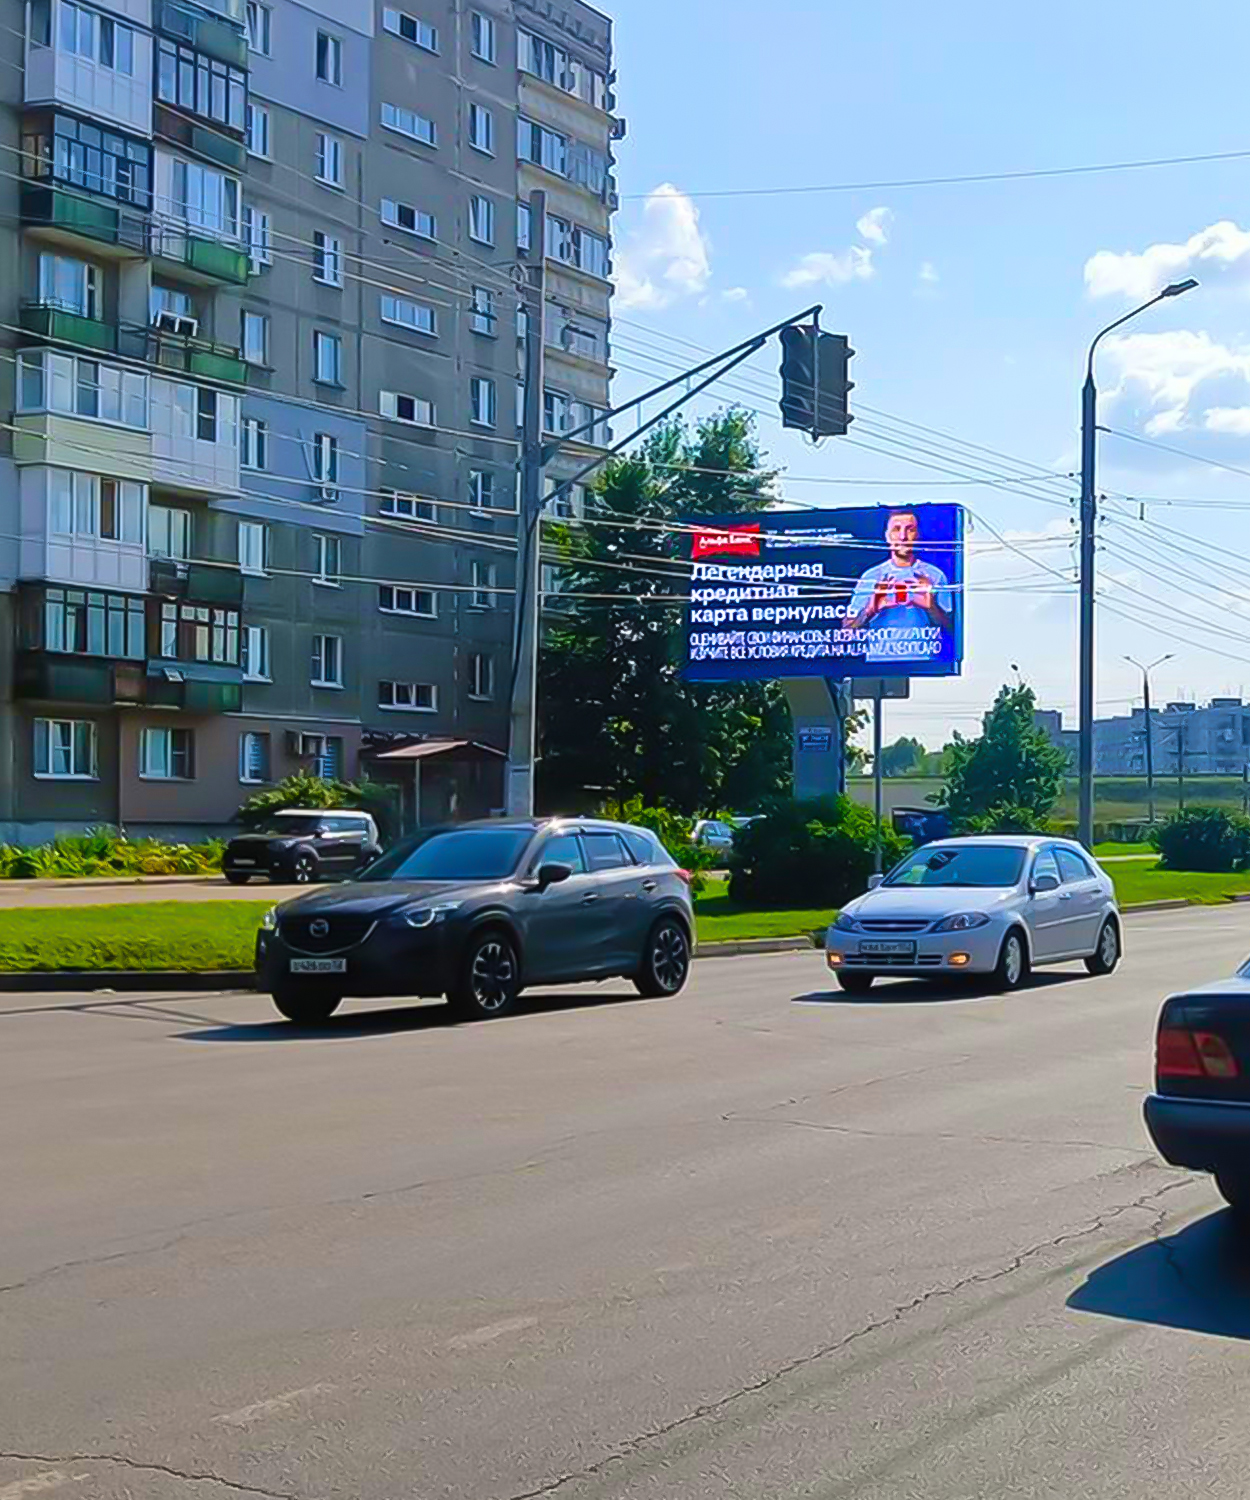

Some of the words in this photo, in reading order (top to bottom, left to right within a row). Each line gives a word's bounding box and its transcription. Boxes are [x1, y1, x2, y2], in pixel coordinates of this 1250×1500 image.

[691, 562, 824, 582] Легендарная
[691, 584, 799, 606] кредитная
[691, 608, 748, 626] карта
[752, 604, 859, 625] вернулась
